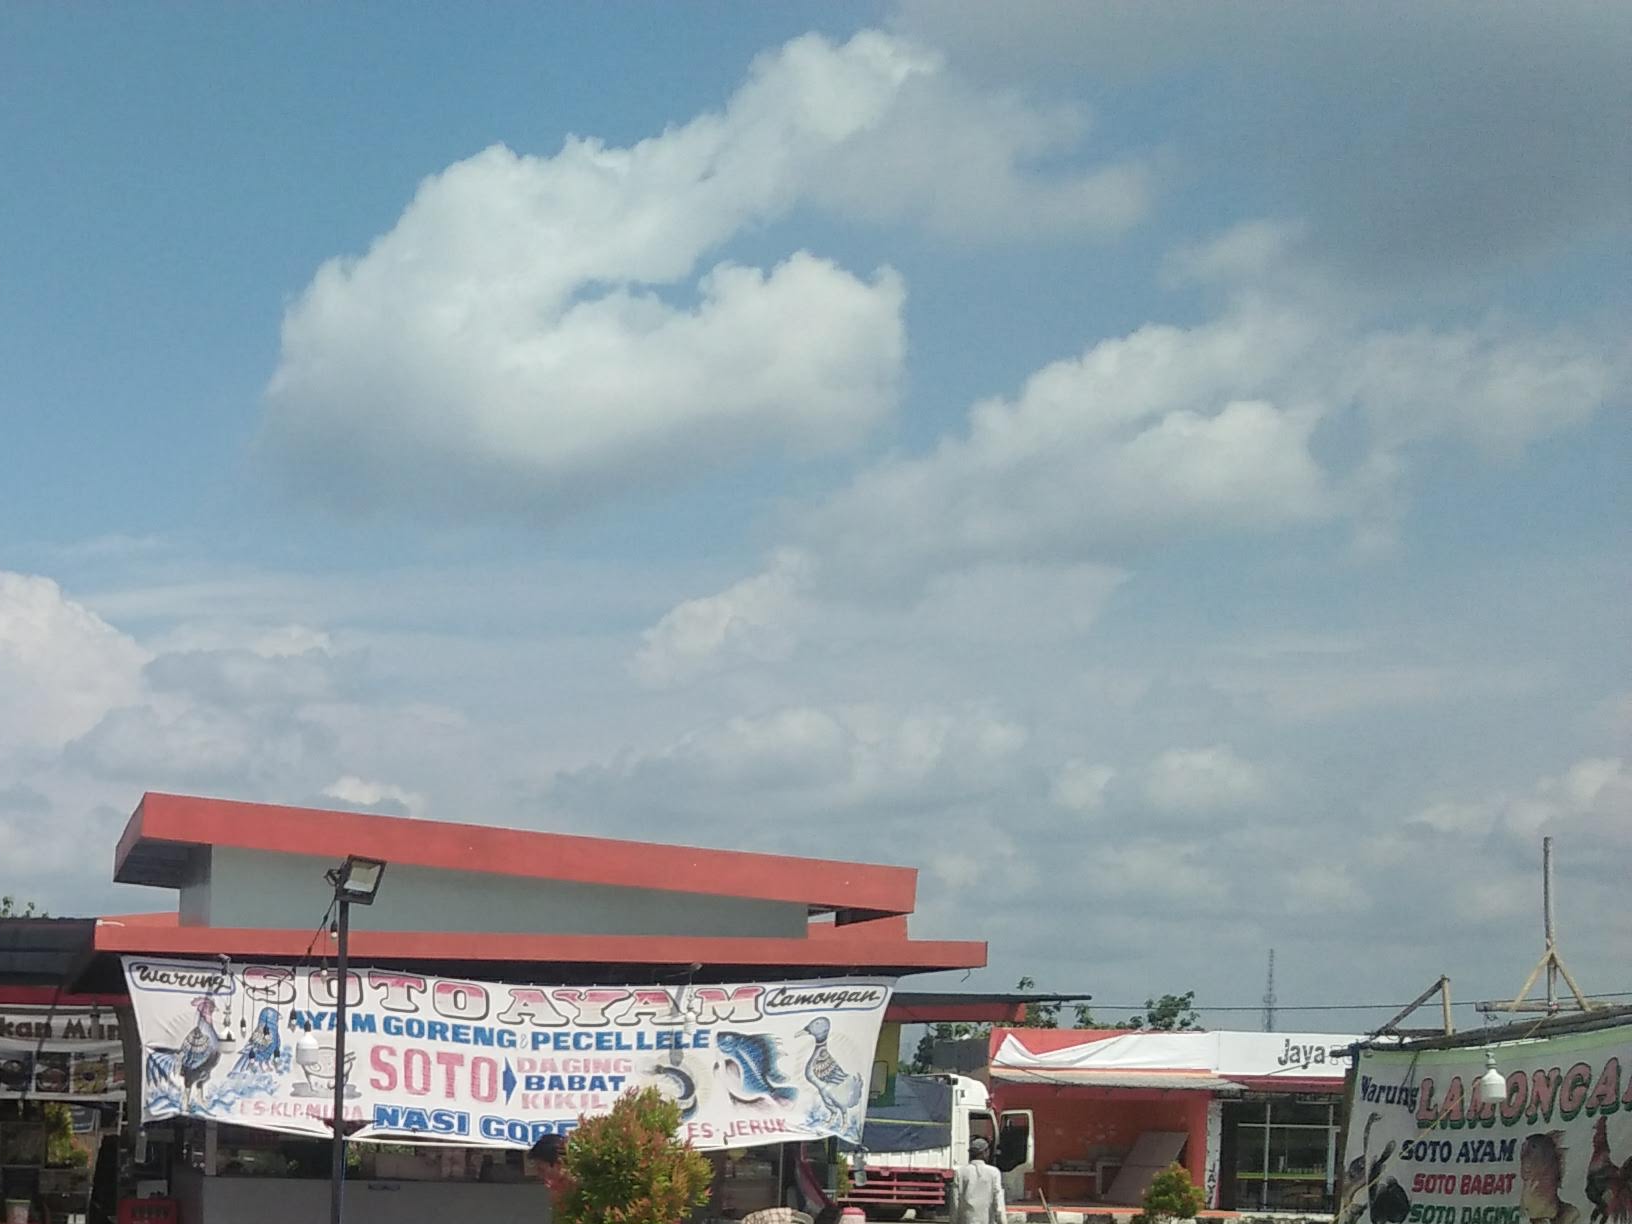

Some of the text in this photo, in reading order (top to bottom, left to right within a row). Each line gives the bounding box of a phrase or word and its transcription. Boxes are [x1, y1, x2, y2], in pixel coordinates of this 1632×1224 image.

[135, 965, 232, 993] Warung
[242, 965, 766, 1028] SOTO AYAM
[767, 986, 881, 1009] Lamongan
[287, 1009, 377, 1033] AYAM
[382, 1015, 517, 1049] GORENG
[1277, 1038, 1325, 1069] Jaya
[369, 1044, 633, 1103] SOTO DAGING
[524, 1075, 626, 1091] BABAT
[521, 1092, 608, 1110] KIKIL
[1416, 1056, 1632, 1129] LAMONGA
[372, 1103, 471, 1136] NASI
[724, 1118, 786, 1138] JERUK
[1399, 1138, 1517, 1163] SOTO AYAM
[1411, 1173, 1516, 1195] SOTO BABAT
